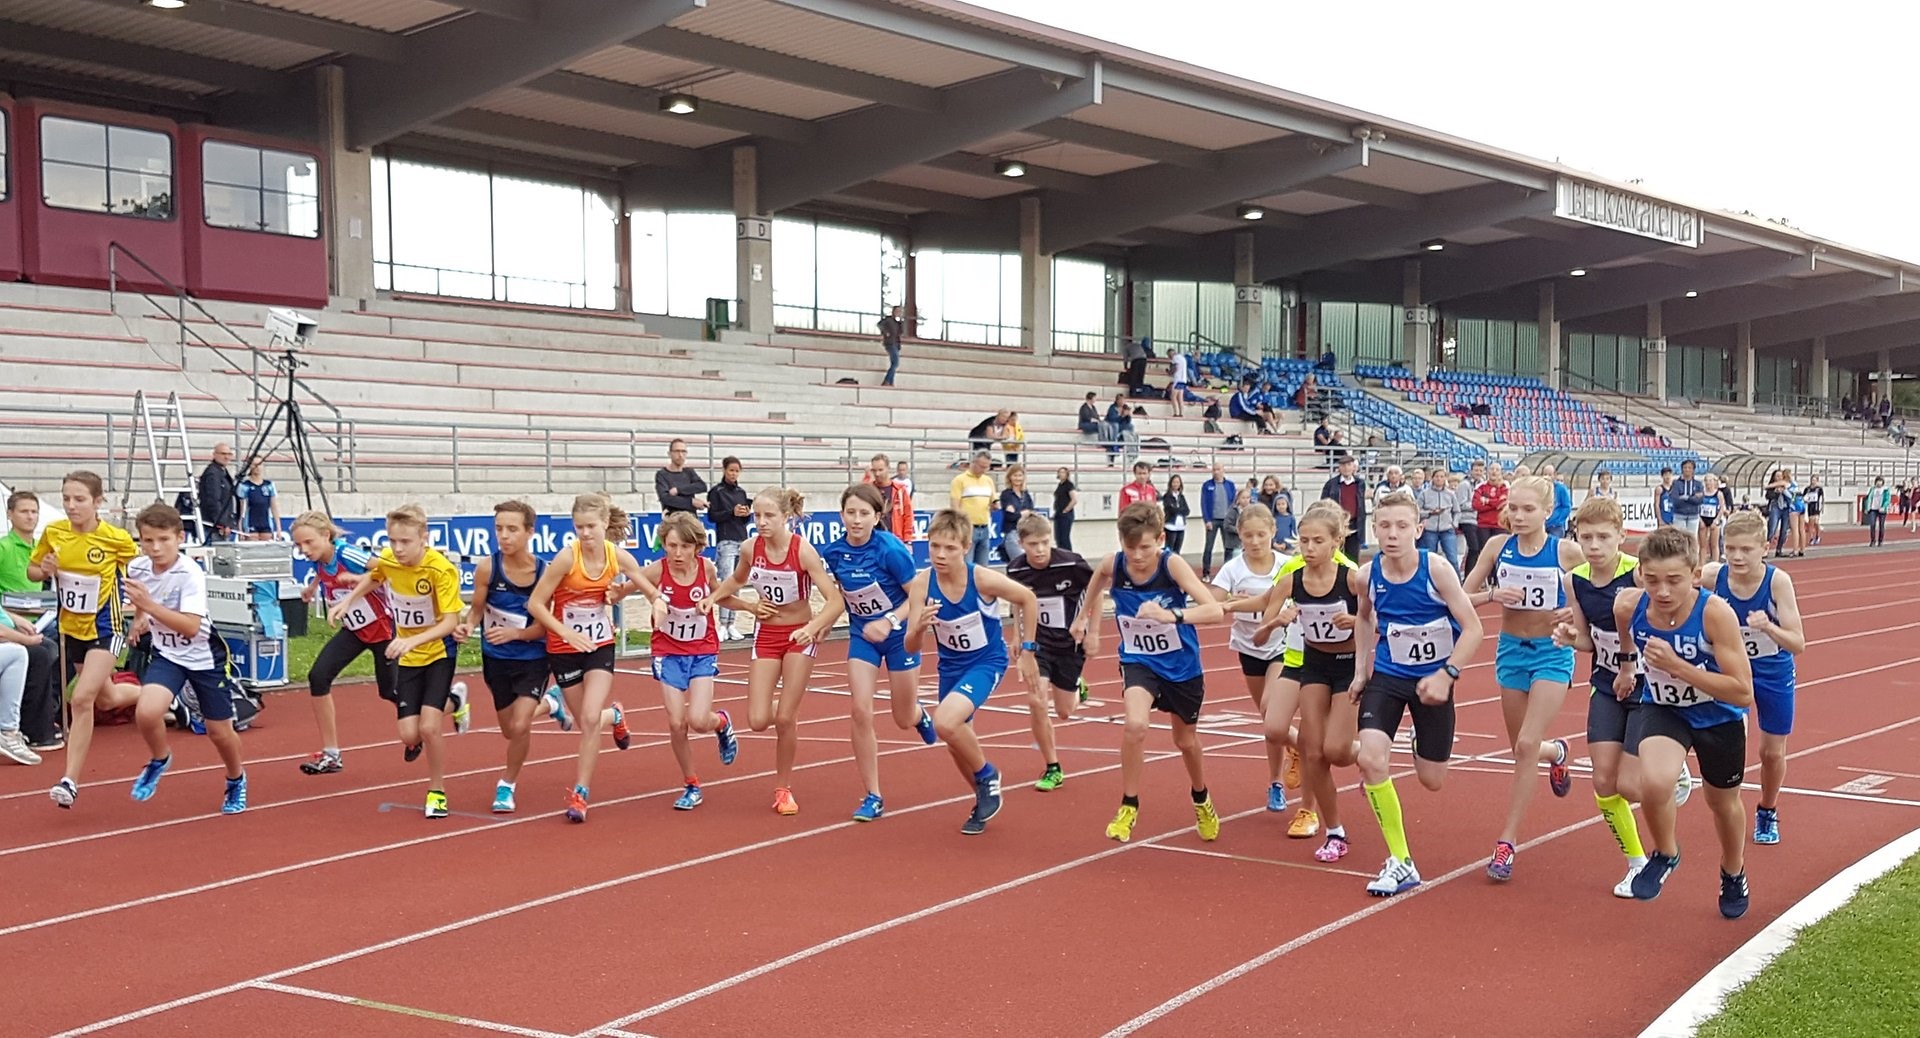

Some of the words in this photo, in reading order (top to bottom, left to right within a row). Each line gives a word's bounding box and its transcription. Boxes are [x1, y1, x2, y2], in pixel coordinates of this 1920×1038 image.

[738, 222, 746, 237] D
[758, 223, 766, 237] D
[1622, 503, 1658, 520] BELKA
[454, 528, 491, 556] VR
[60, 588, 87, 610] 181
[763, 585, 784, 603] 39
[395, 607, 425, 626] 176
[668, 621, 697, 639] 111
[1309, 621, 1336, 640] 12
[948, 633, 972, 650] 46
[1133, 633, 1170, 653] 406
[1408, 642, 1437, 662] 49
[1650, 681, 1699, 705] 134
